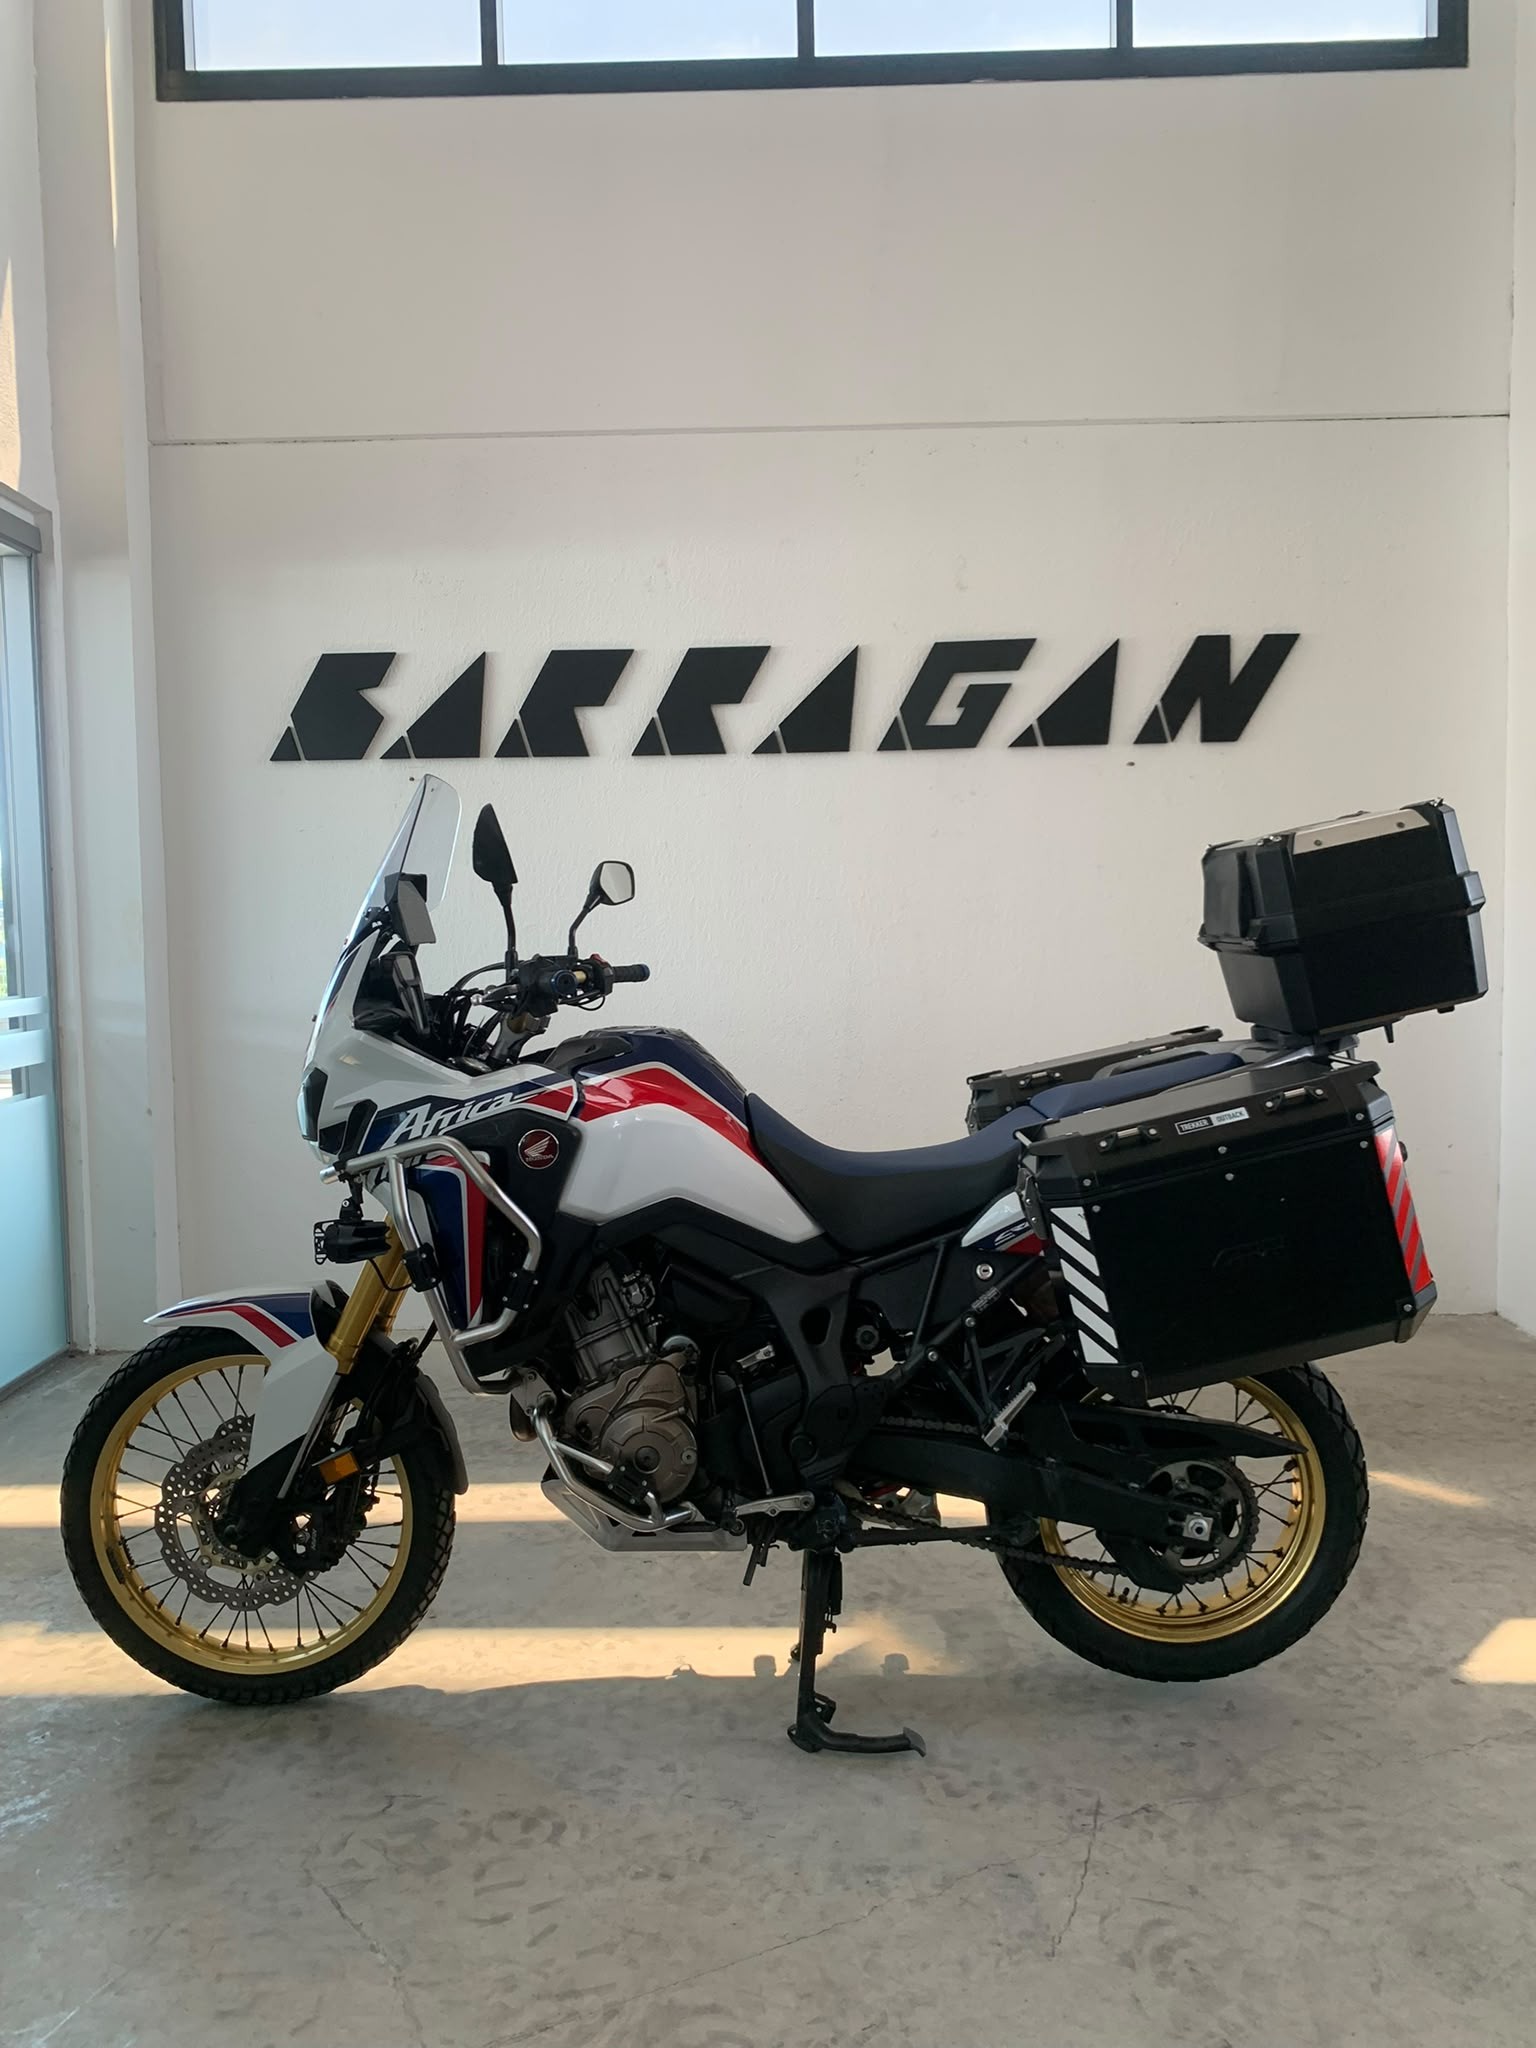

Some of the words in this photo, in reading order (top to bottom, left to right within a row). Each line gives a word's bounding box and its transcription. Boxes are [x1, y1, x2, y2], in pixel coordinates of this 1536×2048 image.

[270, 633, 1301, 761] BARRAGAN
[379, 1091, 522, 1150] Africa
[1180, 1118, 1209, 1132] TREKKER
[1216, 1110, 1245, 1123] OUTBACK
